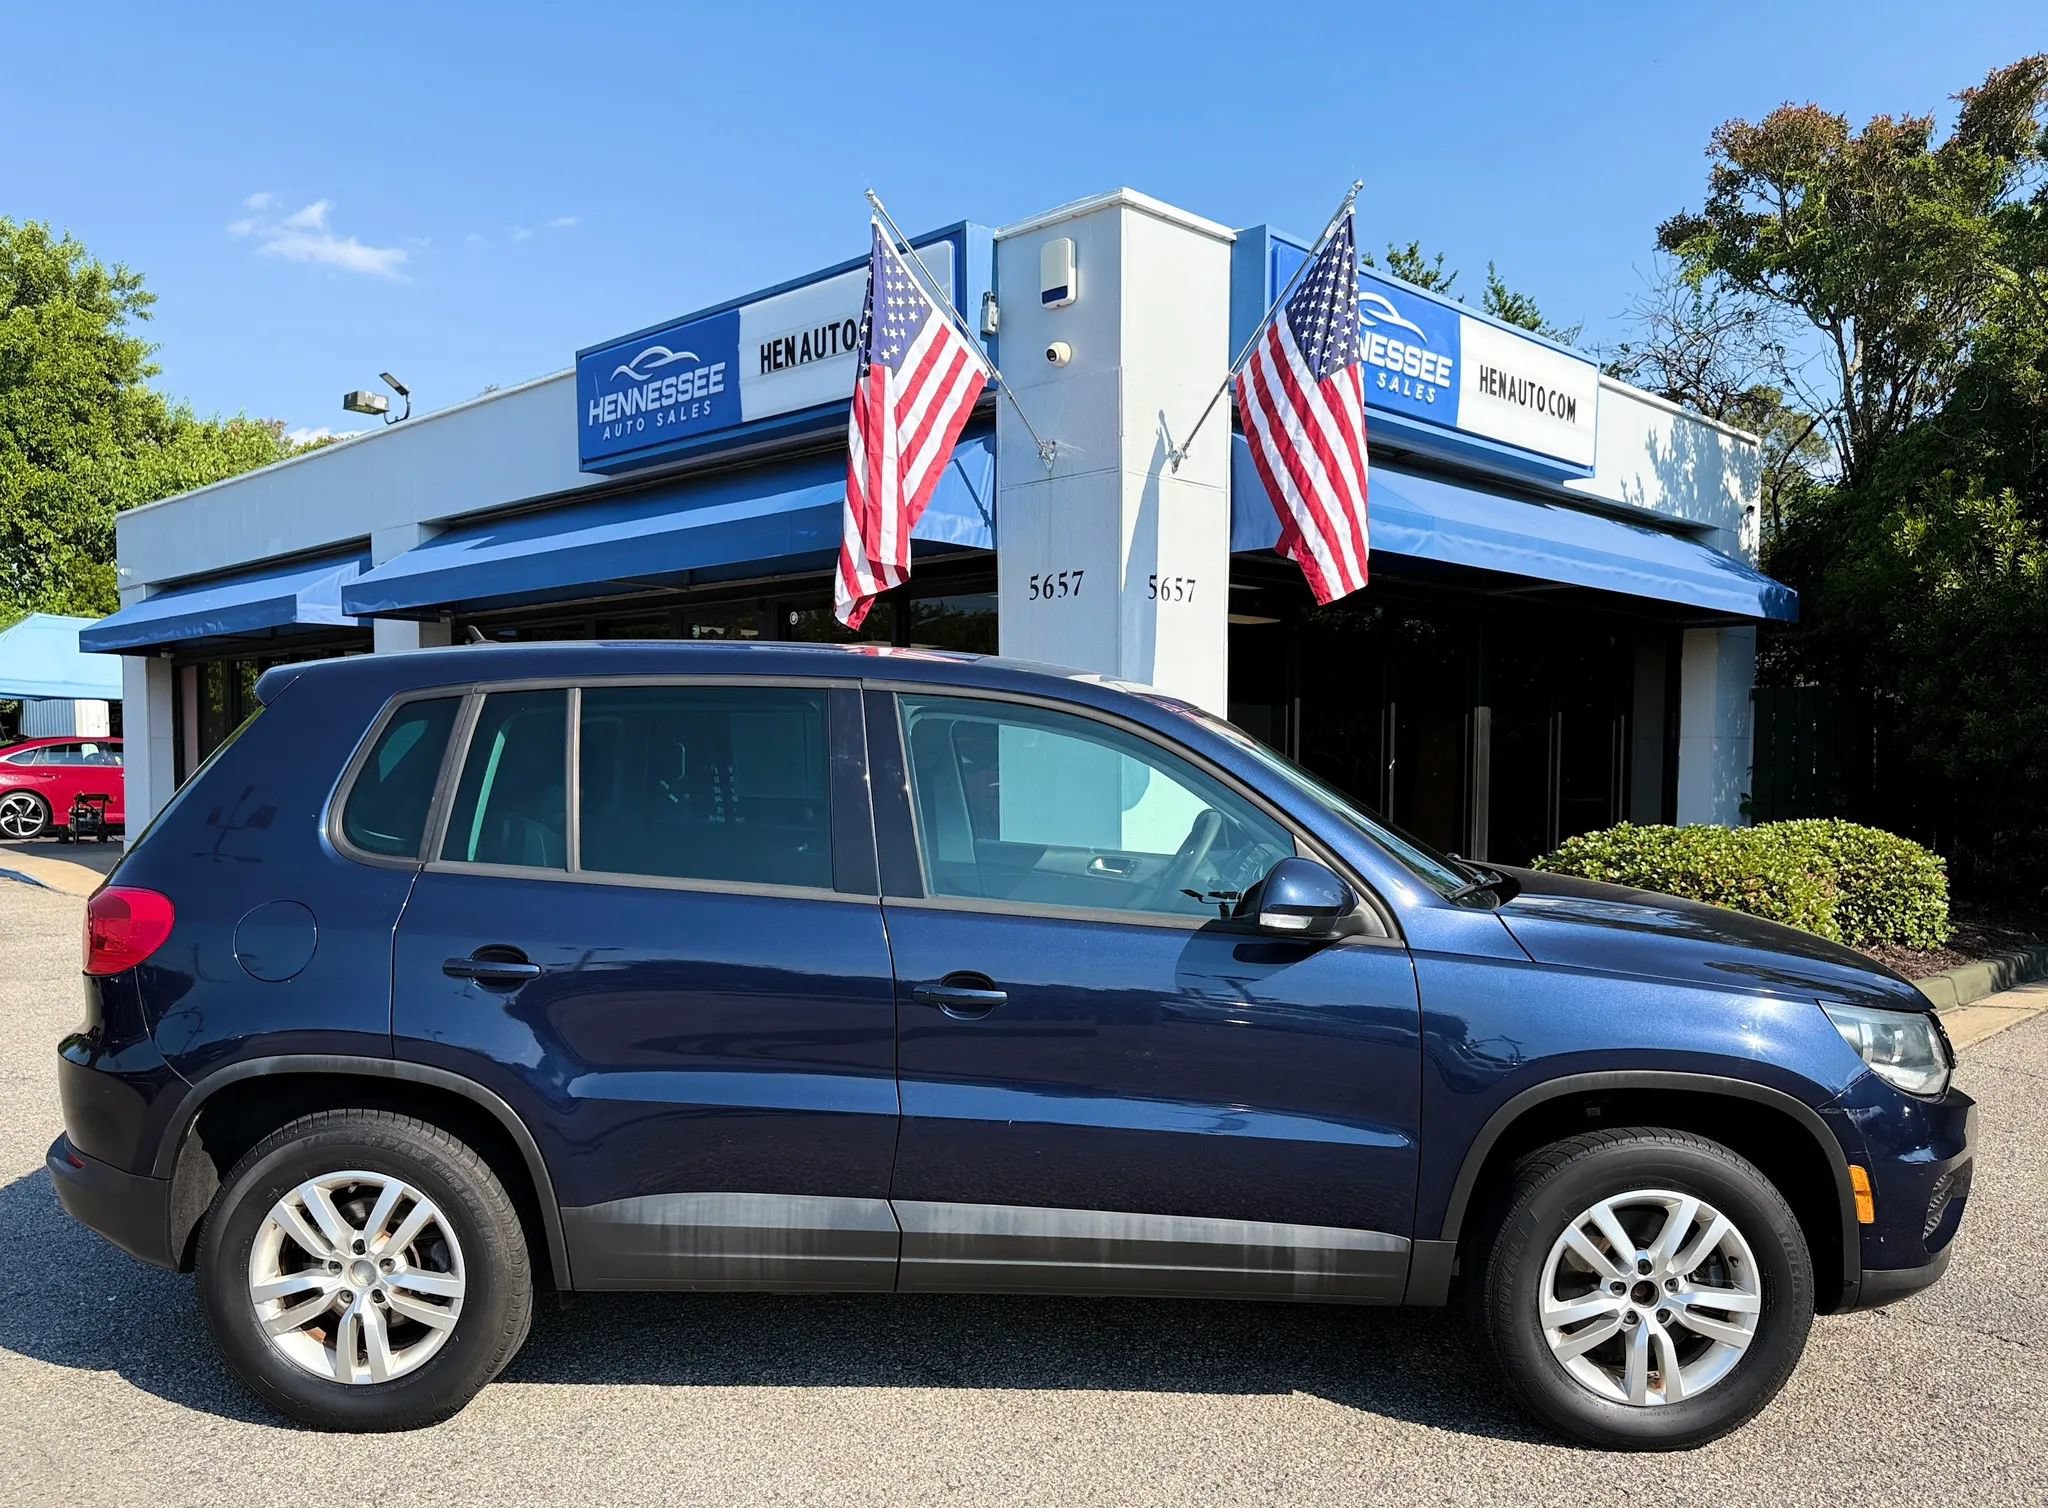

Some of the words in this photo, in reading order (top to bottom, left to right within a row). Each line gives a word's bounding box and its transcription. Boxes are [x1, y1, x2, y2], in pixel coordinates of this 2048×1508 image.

[760, 318, 863, 375] HENAUTO
[1360, 330, 1453, 389] NESSEE
[588, 361, 726, 426] HENNESSEE
[1376, 371, 1435, 404] SALES
[603, 418, 645, 440] AUTO
[656, 400, 712, 427] SALES
[1029, 570, 1085, 601] 5657
[1147, 574, 1196, 603] 5657
